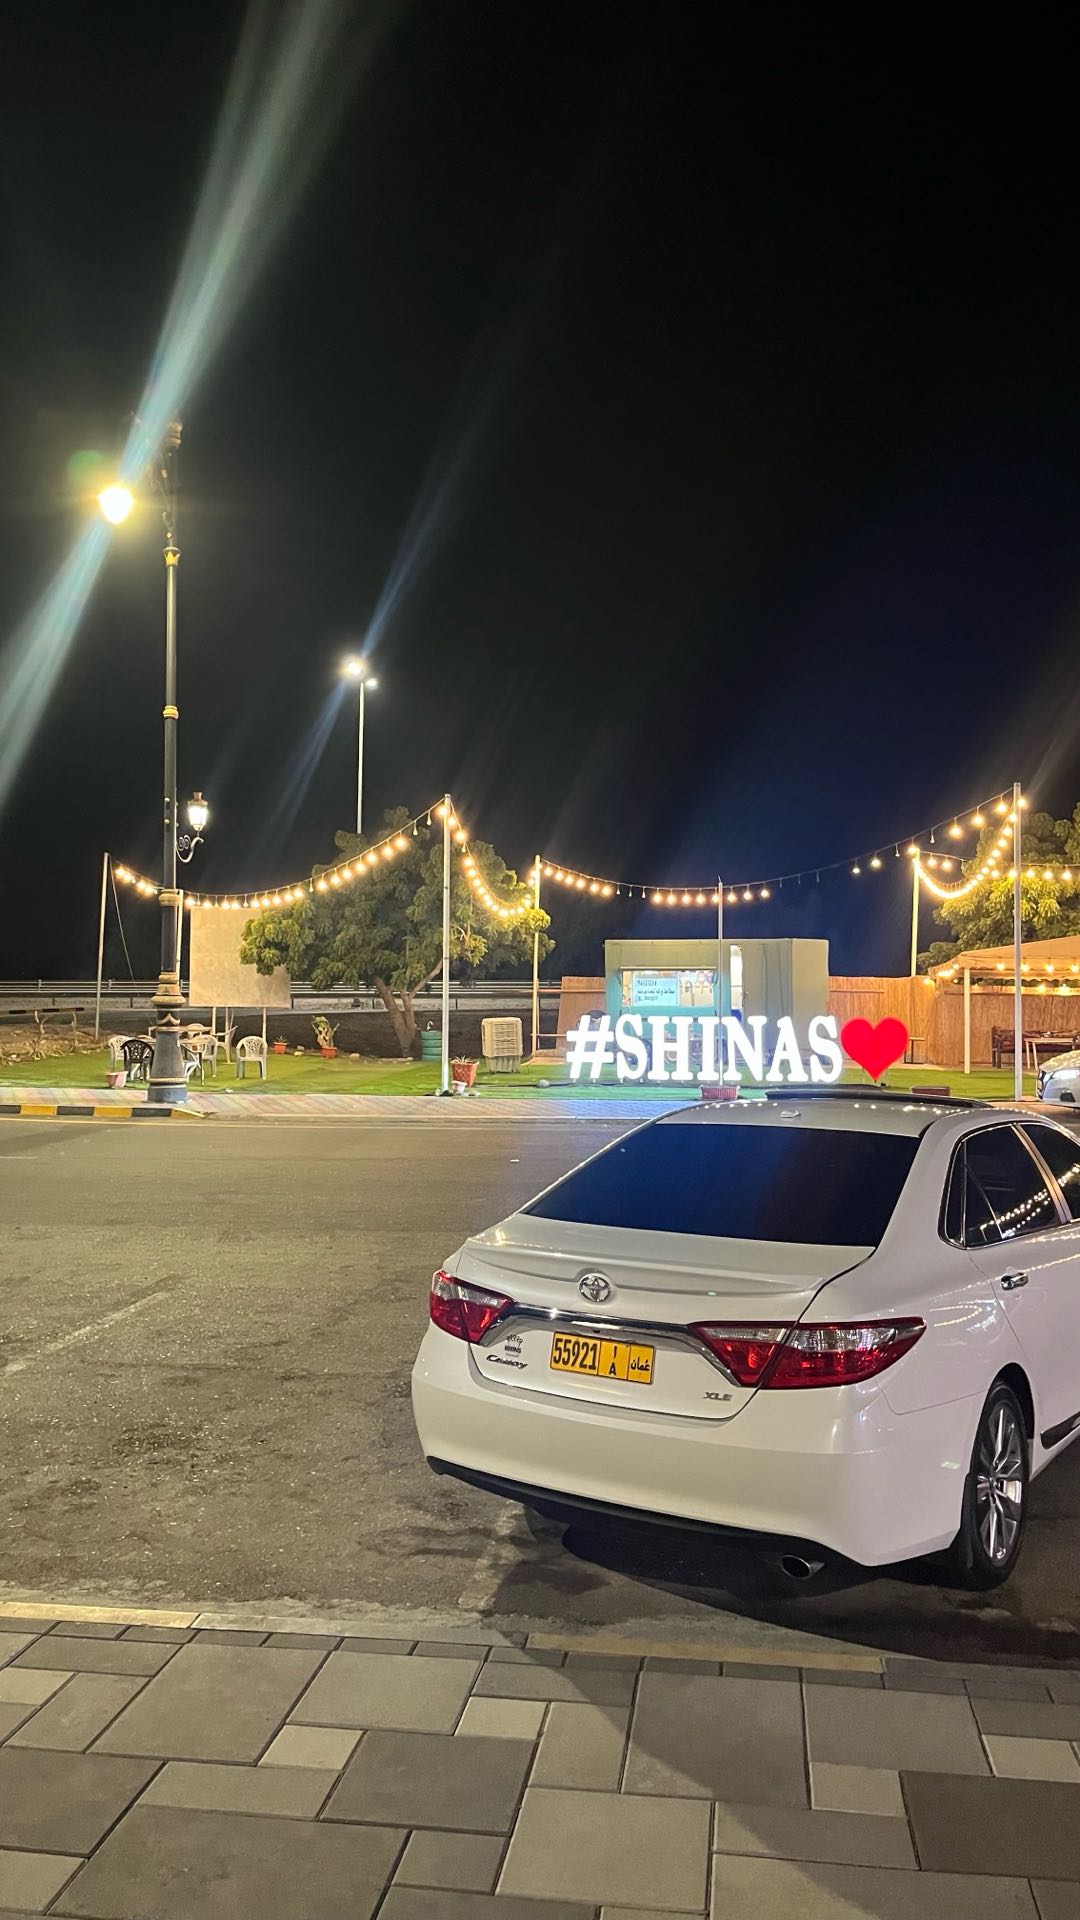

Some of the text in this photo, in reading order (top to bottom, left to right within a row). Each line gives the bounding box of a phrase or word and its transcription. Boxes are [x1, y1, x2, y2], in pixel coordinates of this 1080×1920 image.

[566, 1014, 843, 1083] #SHINAS
[553, 1338, 597, 1370] 55921
[608, 1362, 617, 1376] A
[703, 1391, 733, 1401] XLE
